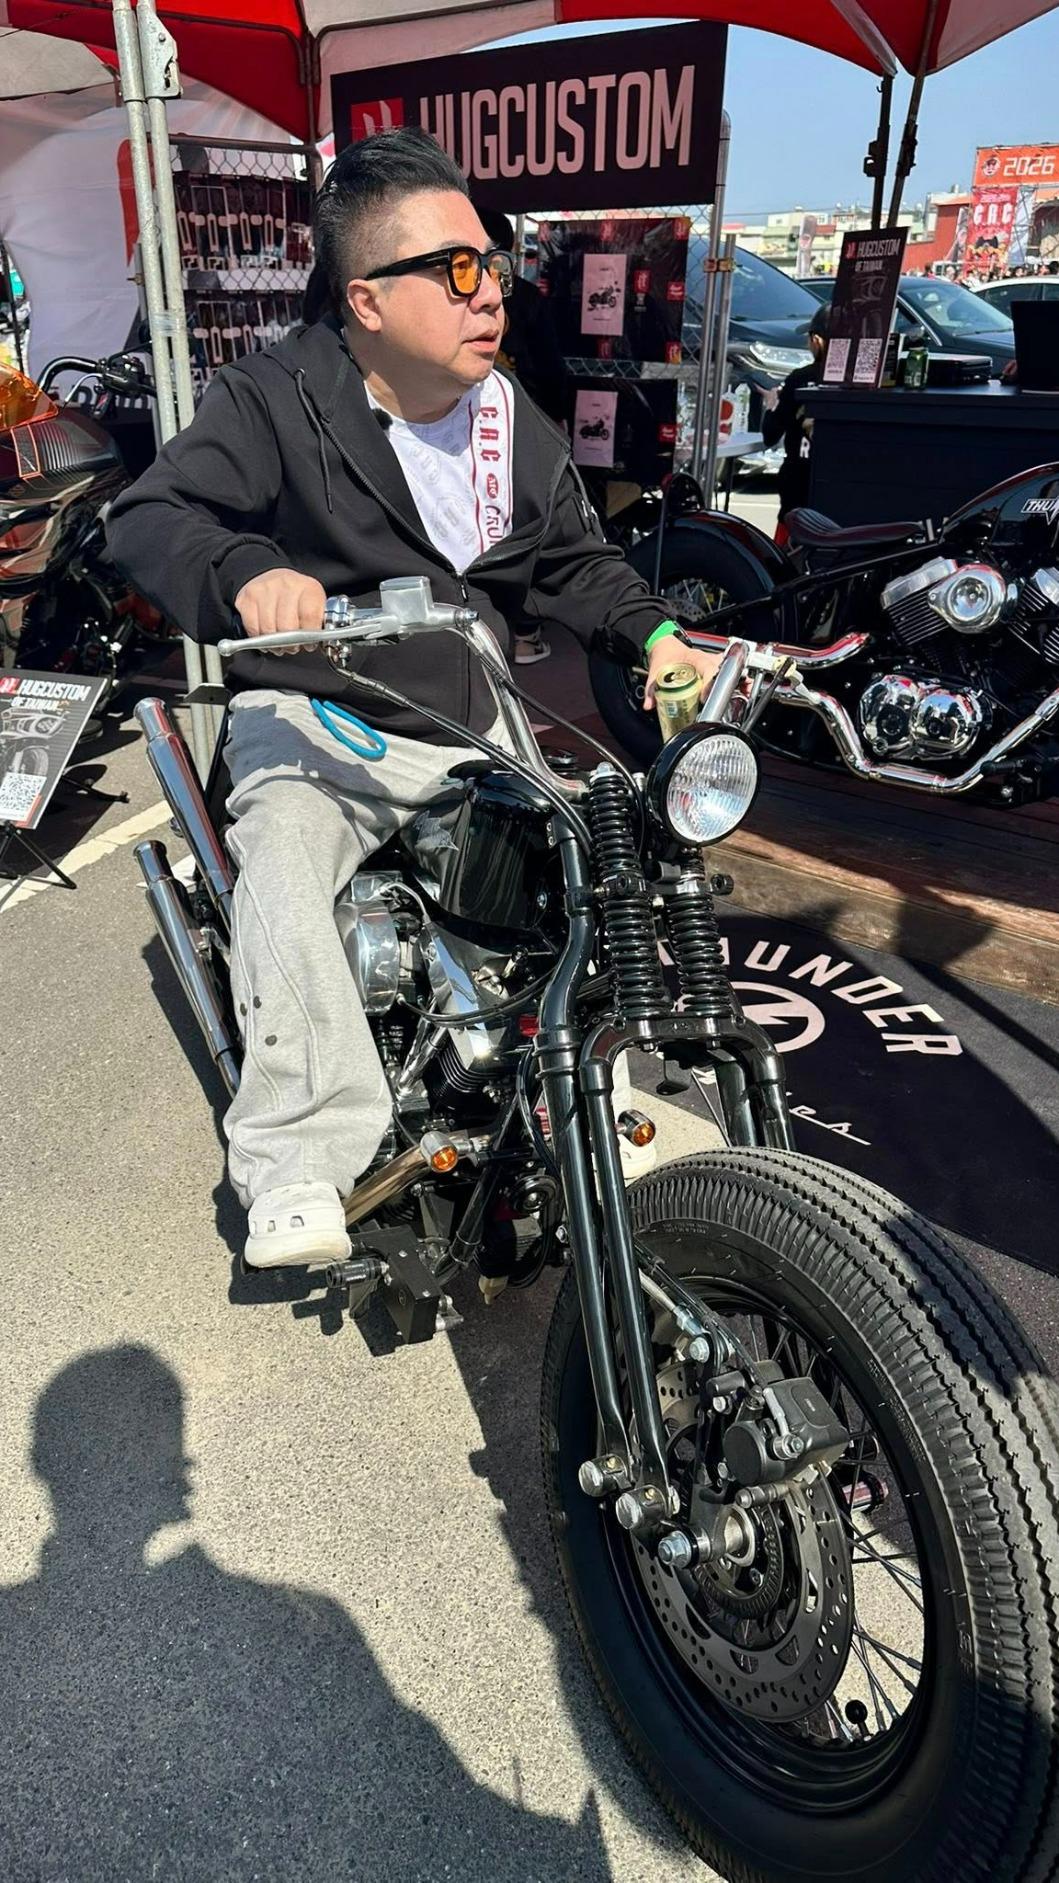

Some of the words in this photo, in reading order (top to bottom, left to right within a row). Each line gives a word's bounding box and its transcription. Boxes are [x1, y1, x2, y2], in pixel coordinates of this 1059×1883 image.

[419, 65, 696, 181] HUGCUSTOM
[1003, 155, 1056, 177] 2026
[485, 505, 503, 544] CRU
[20, 679, 91, 701] HUGCUSTOM
